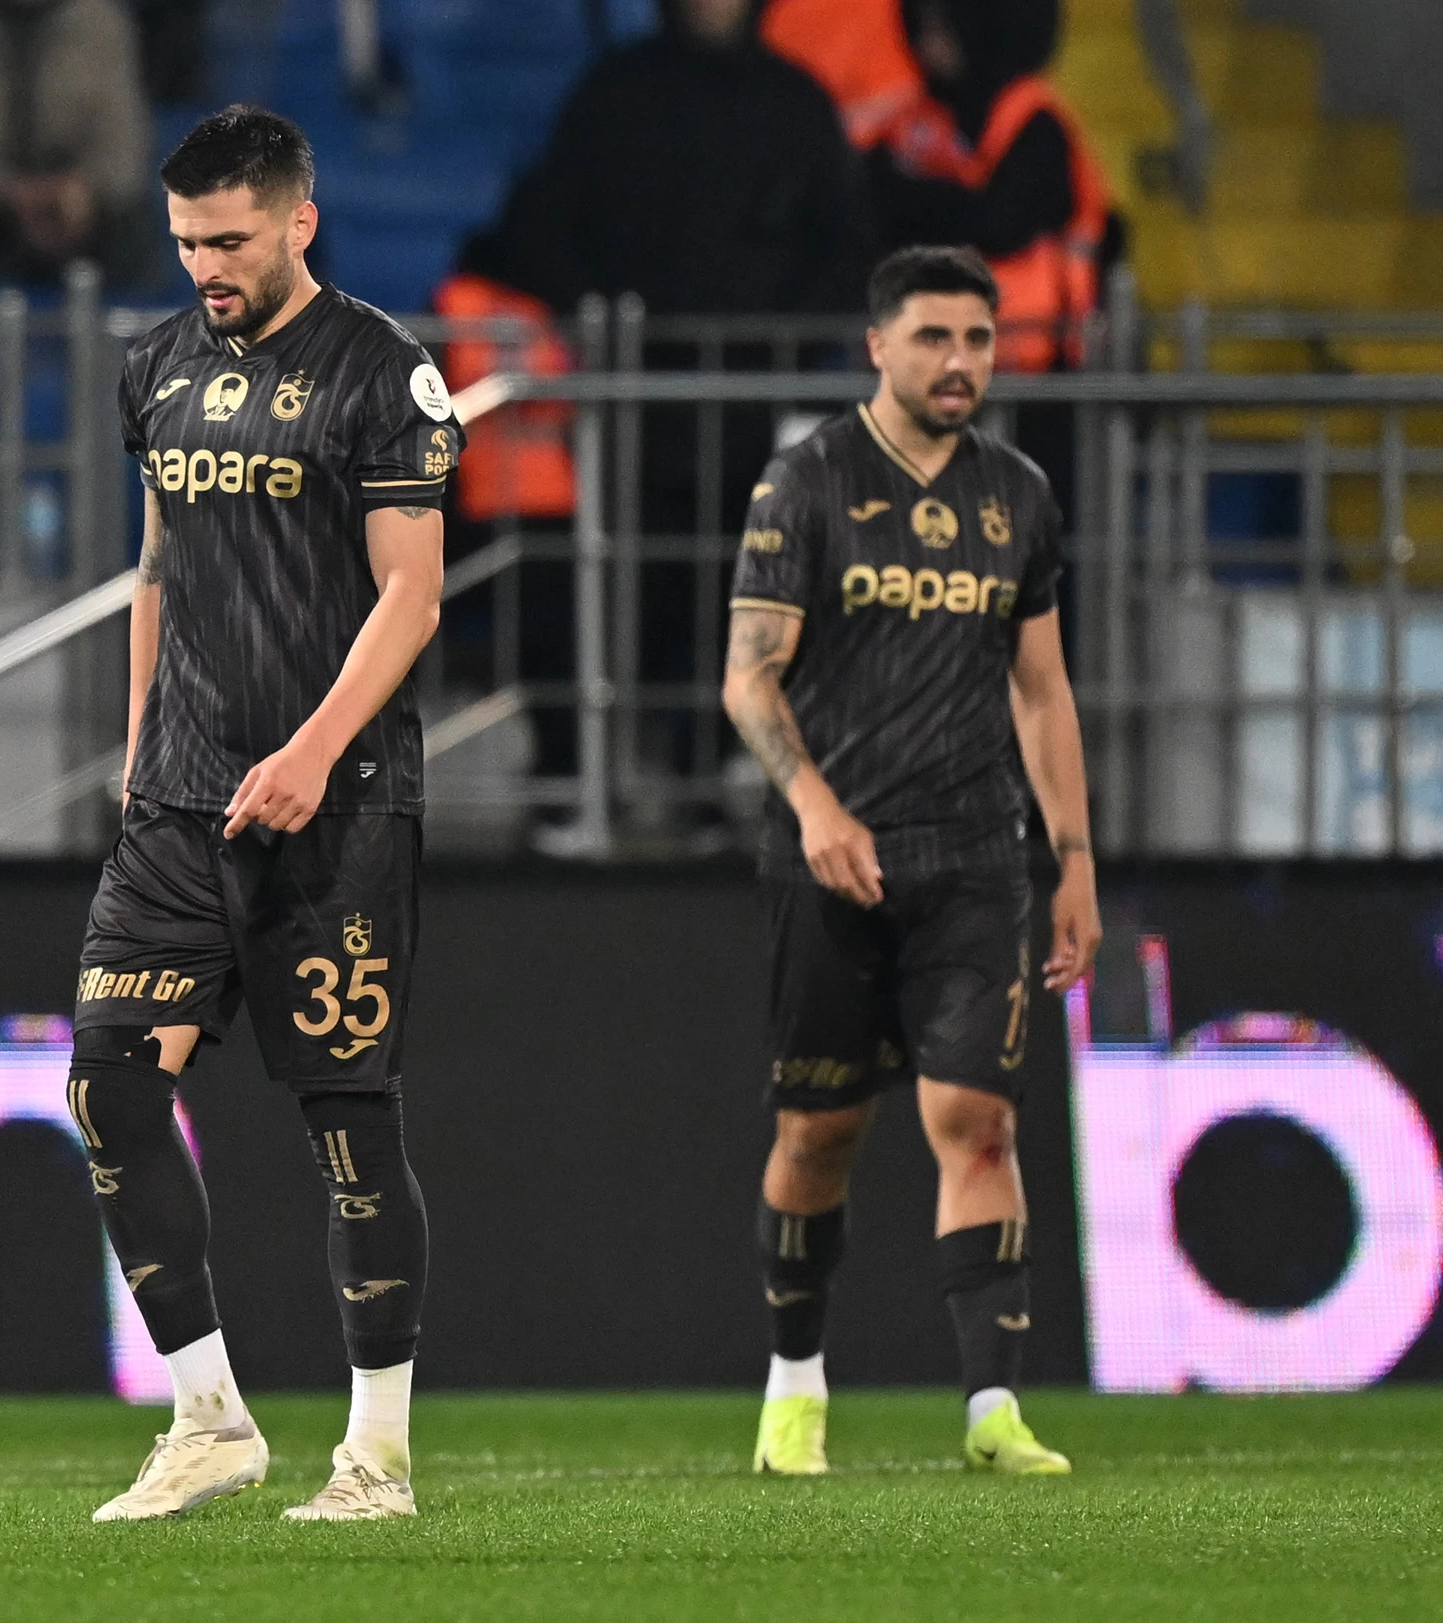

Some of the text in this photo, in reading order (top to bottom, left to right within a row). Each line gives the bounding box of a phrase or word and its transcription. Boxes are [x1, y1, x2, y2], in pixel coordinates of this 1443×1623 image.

[841, 564, 1018, 620] papara
[80, 966, 196, 1003] Rent Go
[292, 957, 390, 1038] 35
